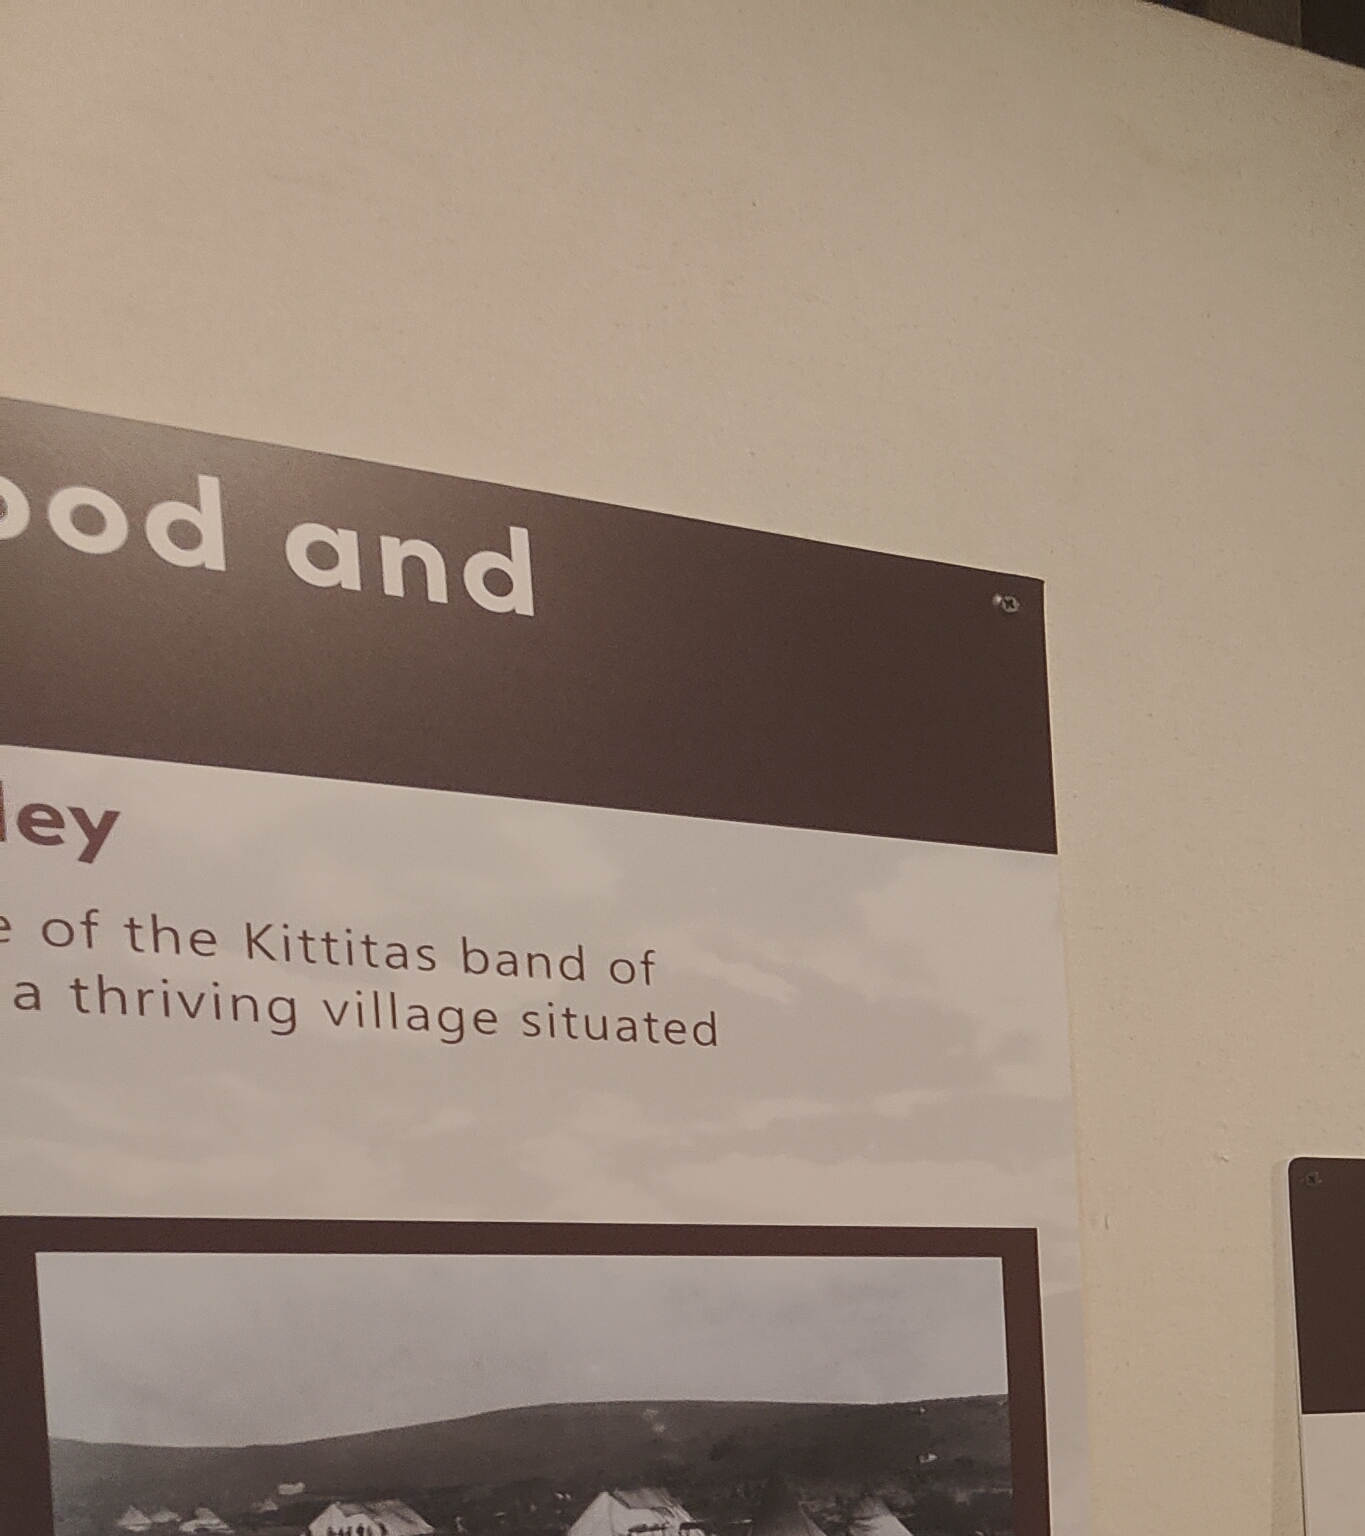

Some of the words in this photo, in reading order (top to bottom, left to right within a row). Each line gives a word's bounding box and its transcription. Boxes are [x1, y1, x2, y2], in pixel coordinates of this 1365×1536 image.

[285, 522, 533, 615] and
[40, 907, 100, 950] of
[121, 911, 218, 957] the
[244, 920, 437, 972] Kittitas
[460, 934, 585, 982] band
[608, 948, 656, 987] of
[12, 980, 42, 1011] a
[67, 972, 297, 1037] thriving
[320, 988, 498, 1045] village
[520, 1000, 718, 1047] situated
